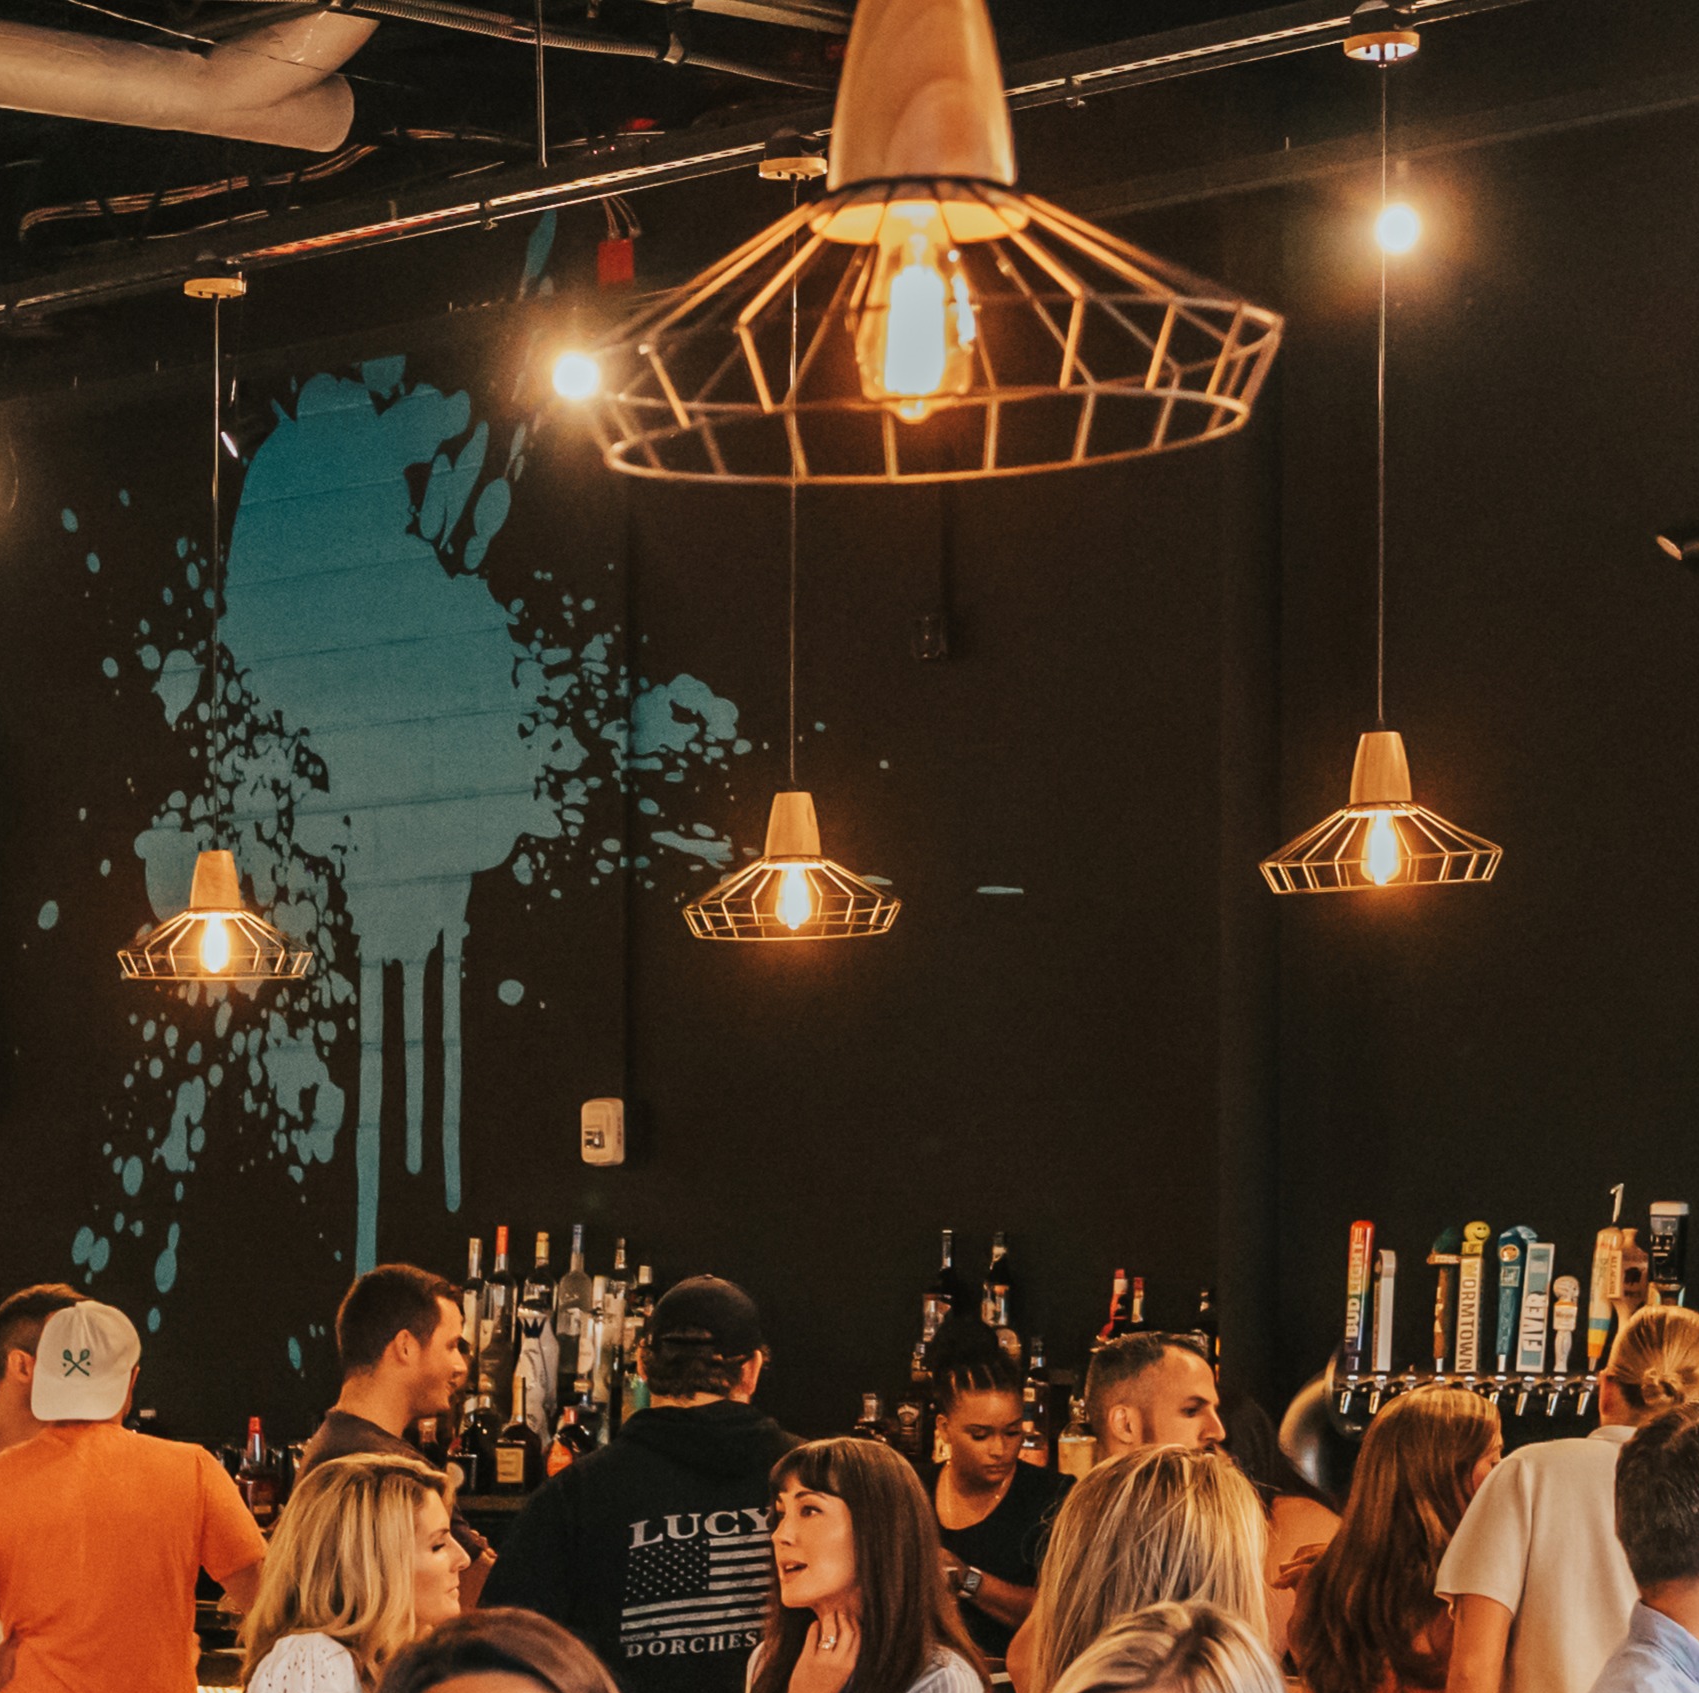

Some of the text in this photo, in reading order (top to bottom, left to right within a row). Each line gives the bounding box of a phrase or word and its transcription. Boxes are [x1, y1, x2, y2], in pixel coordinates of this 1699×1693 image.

[1345, 1297, 1360, 1338] BUD
[1459, 1259, 1482, 1371] WORMTOWN
[628, 1506, 773, 1550] LUCY
